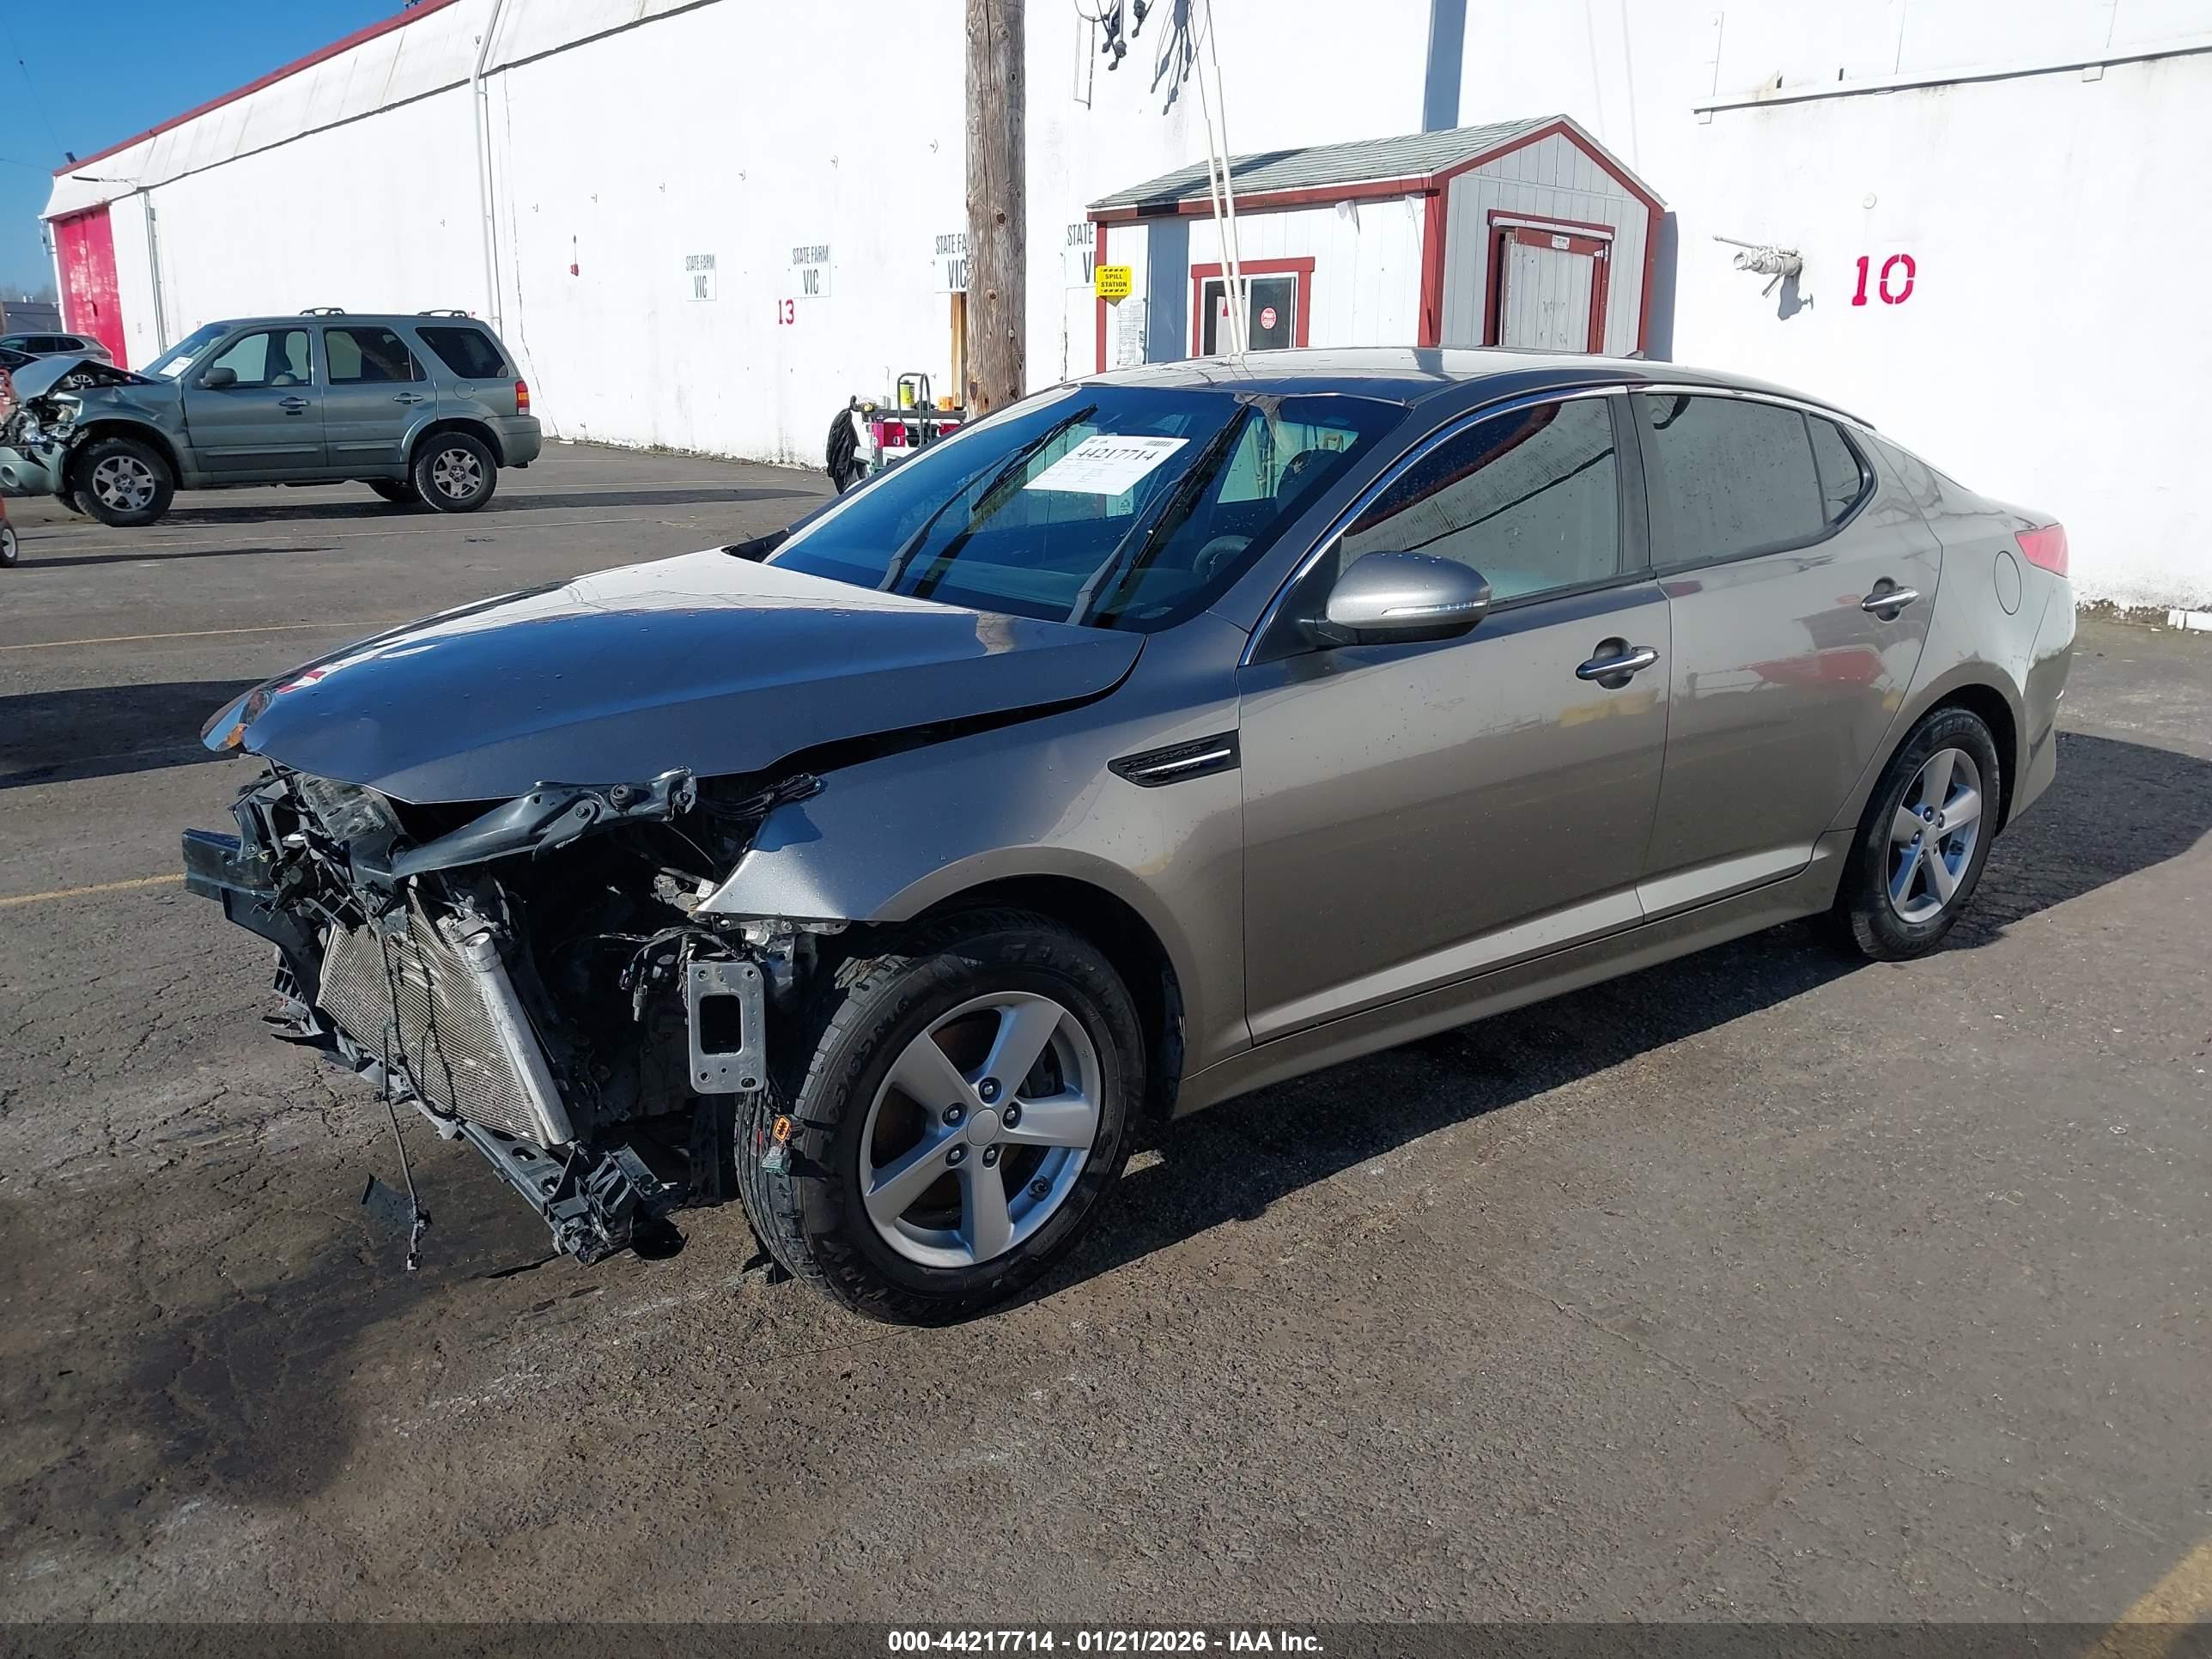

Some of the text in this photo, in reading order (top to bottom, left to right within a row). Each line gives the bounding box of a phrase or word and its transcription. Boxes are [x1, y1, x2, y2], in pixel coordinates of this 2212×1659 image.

[935, 233, 967, 255] STATE FA
[1067, 222, 1094, 246] STATE
[685, 253, 715, 272] STATE FARM
[792, 245, 829, 265] STATE FARM
[803, 268, 819, 295] VIC
[947, 258, 967, 289] VIC
[1851, 253, 1917, 307] 10
[694, 274, 708, 299] VIC
[778, 299, 794, 325] 13
